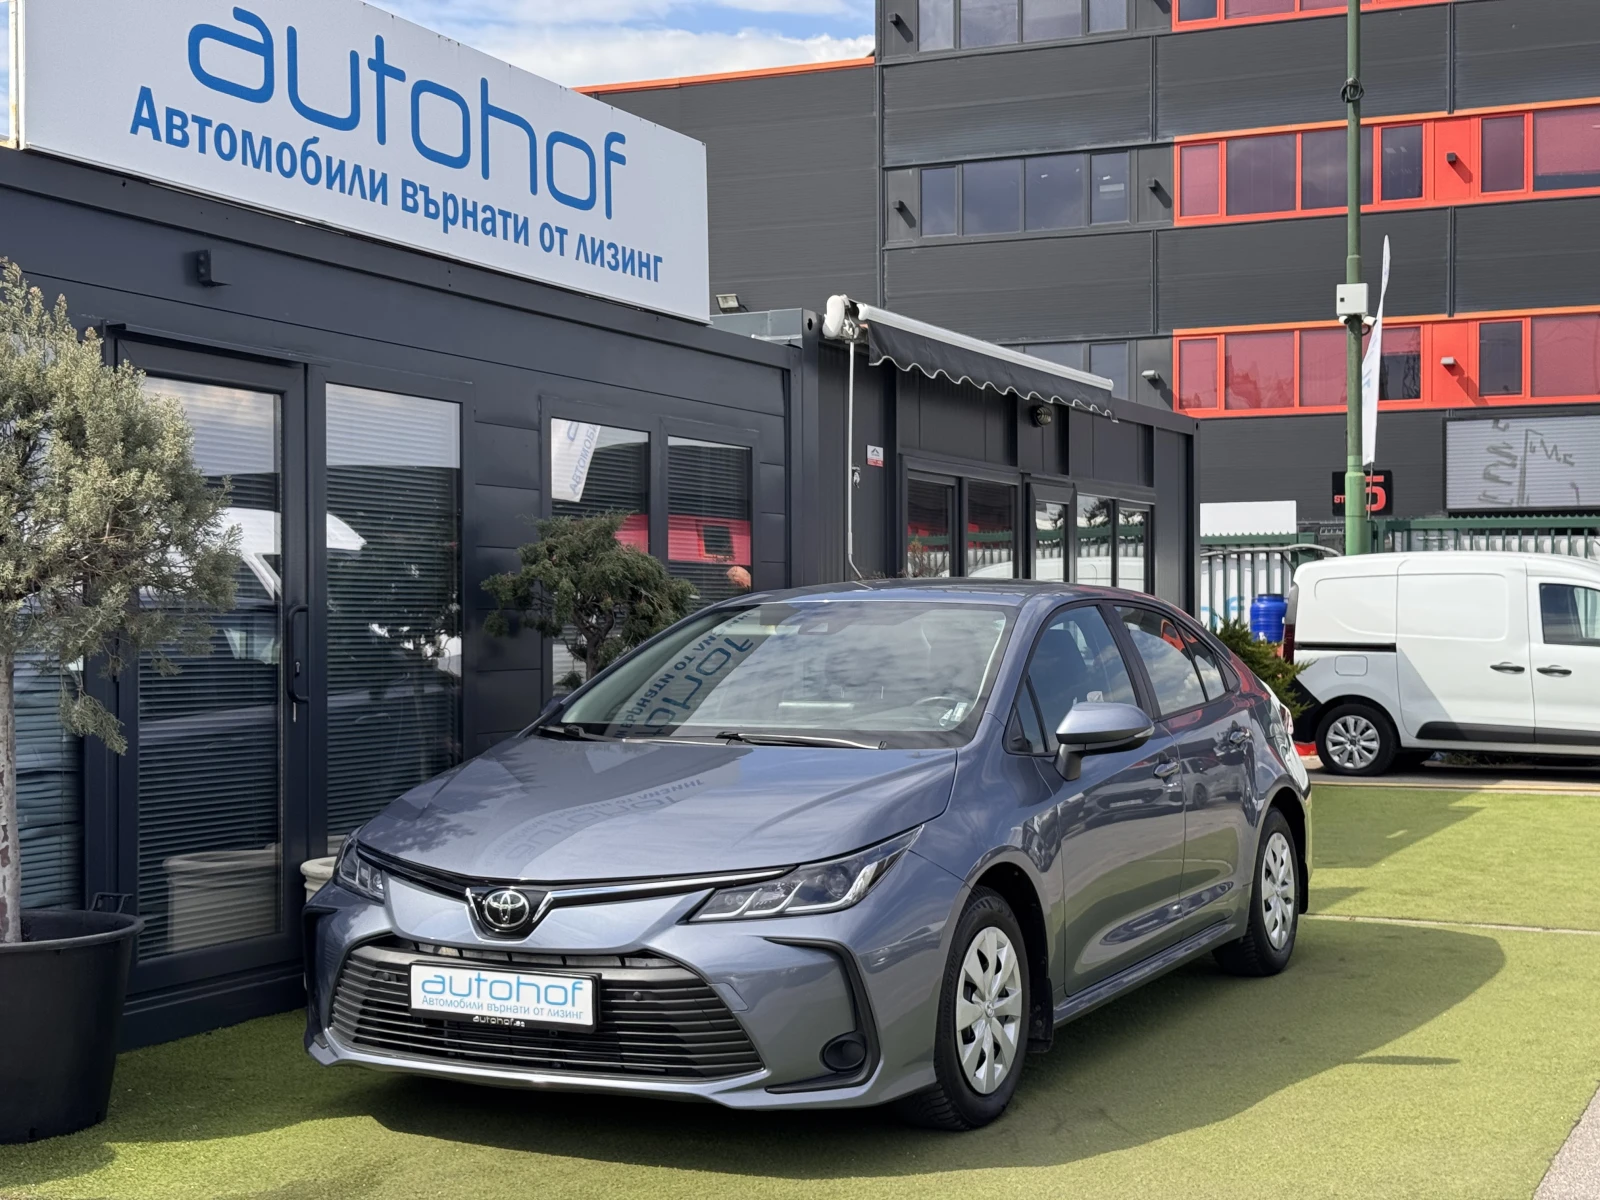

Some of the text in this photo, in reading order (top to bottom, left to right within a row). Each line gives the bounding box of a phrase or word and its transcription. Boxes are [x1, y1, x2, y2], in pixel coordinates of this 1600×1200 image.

[187, 6, 627, 220] autohof
[129, 85, 664, 283] Автомобили върнати от лизинг
[421, 972, 584, 1008] autohof
[421, 995, 584, 1020] Автомобили върнати от лизинг
